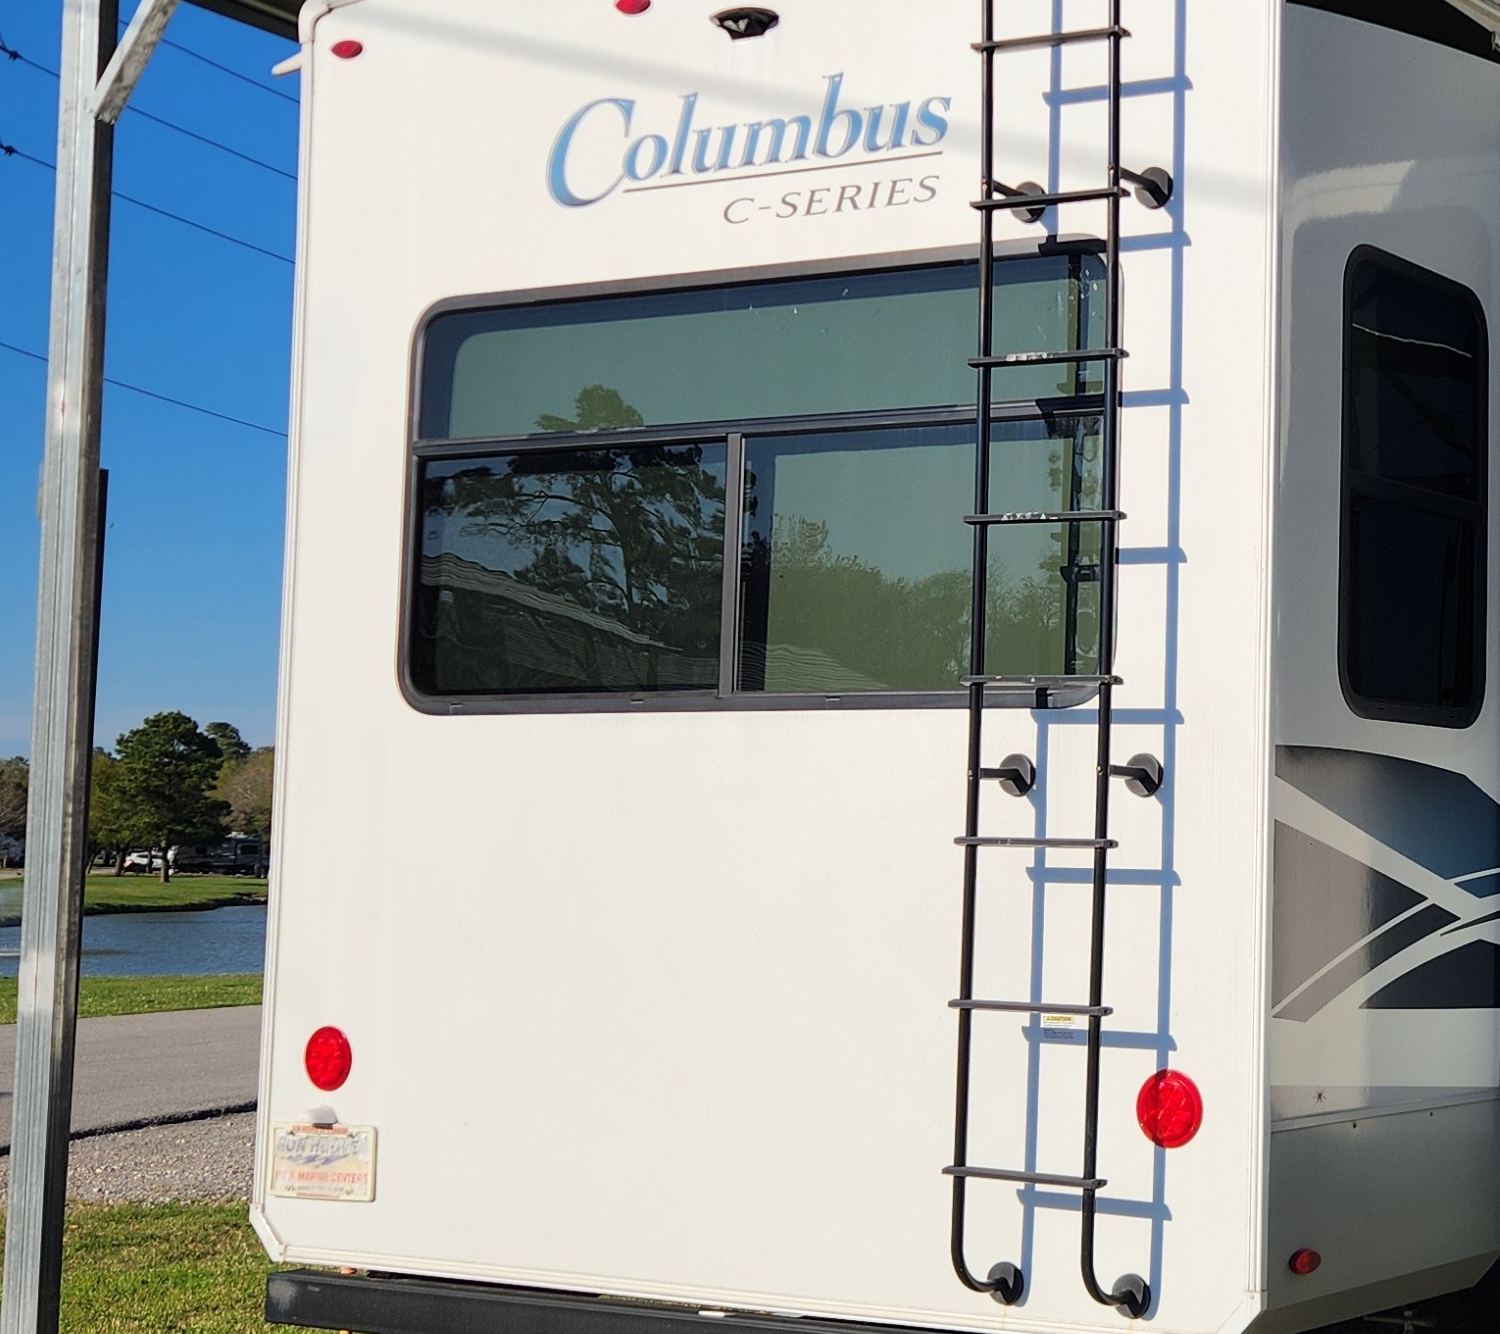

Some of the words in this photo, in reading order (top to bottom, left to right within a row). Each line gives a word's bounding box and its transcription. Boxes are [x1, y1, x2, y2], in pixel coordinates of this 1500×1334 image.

[545, 71, 952, 209] Columbus
[722, 174, 941, 225] C-SERIES
[331, 1173, 368, 1184] CENTERS
